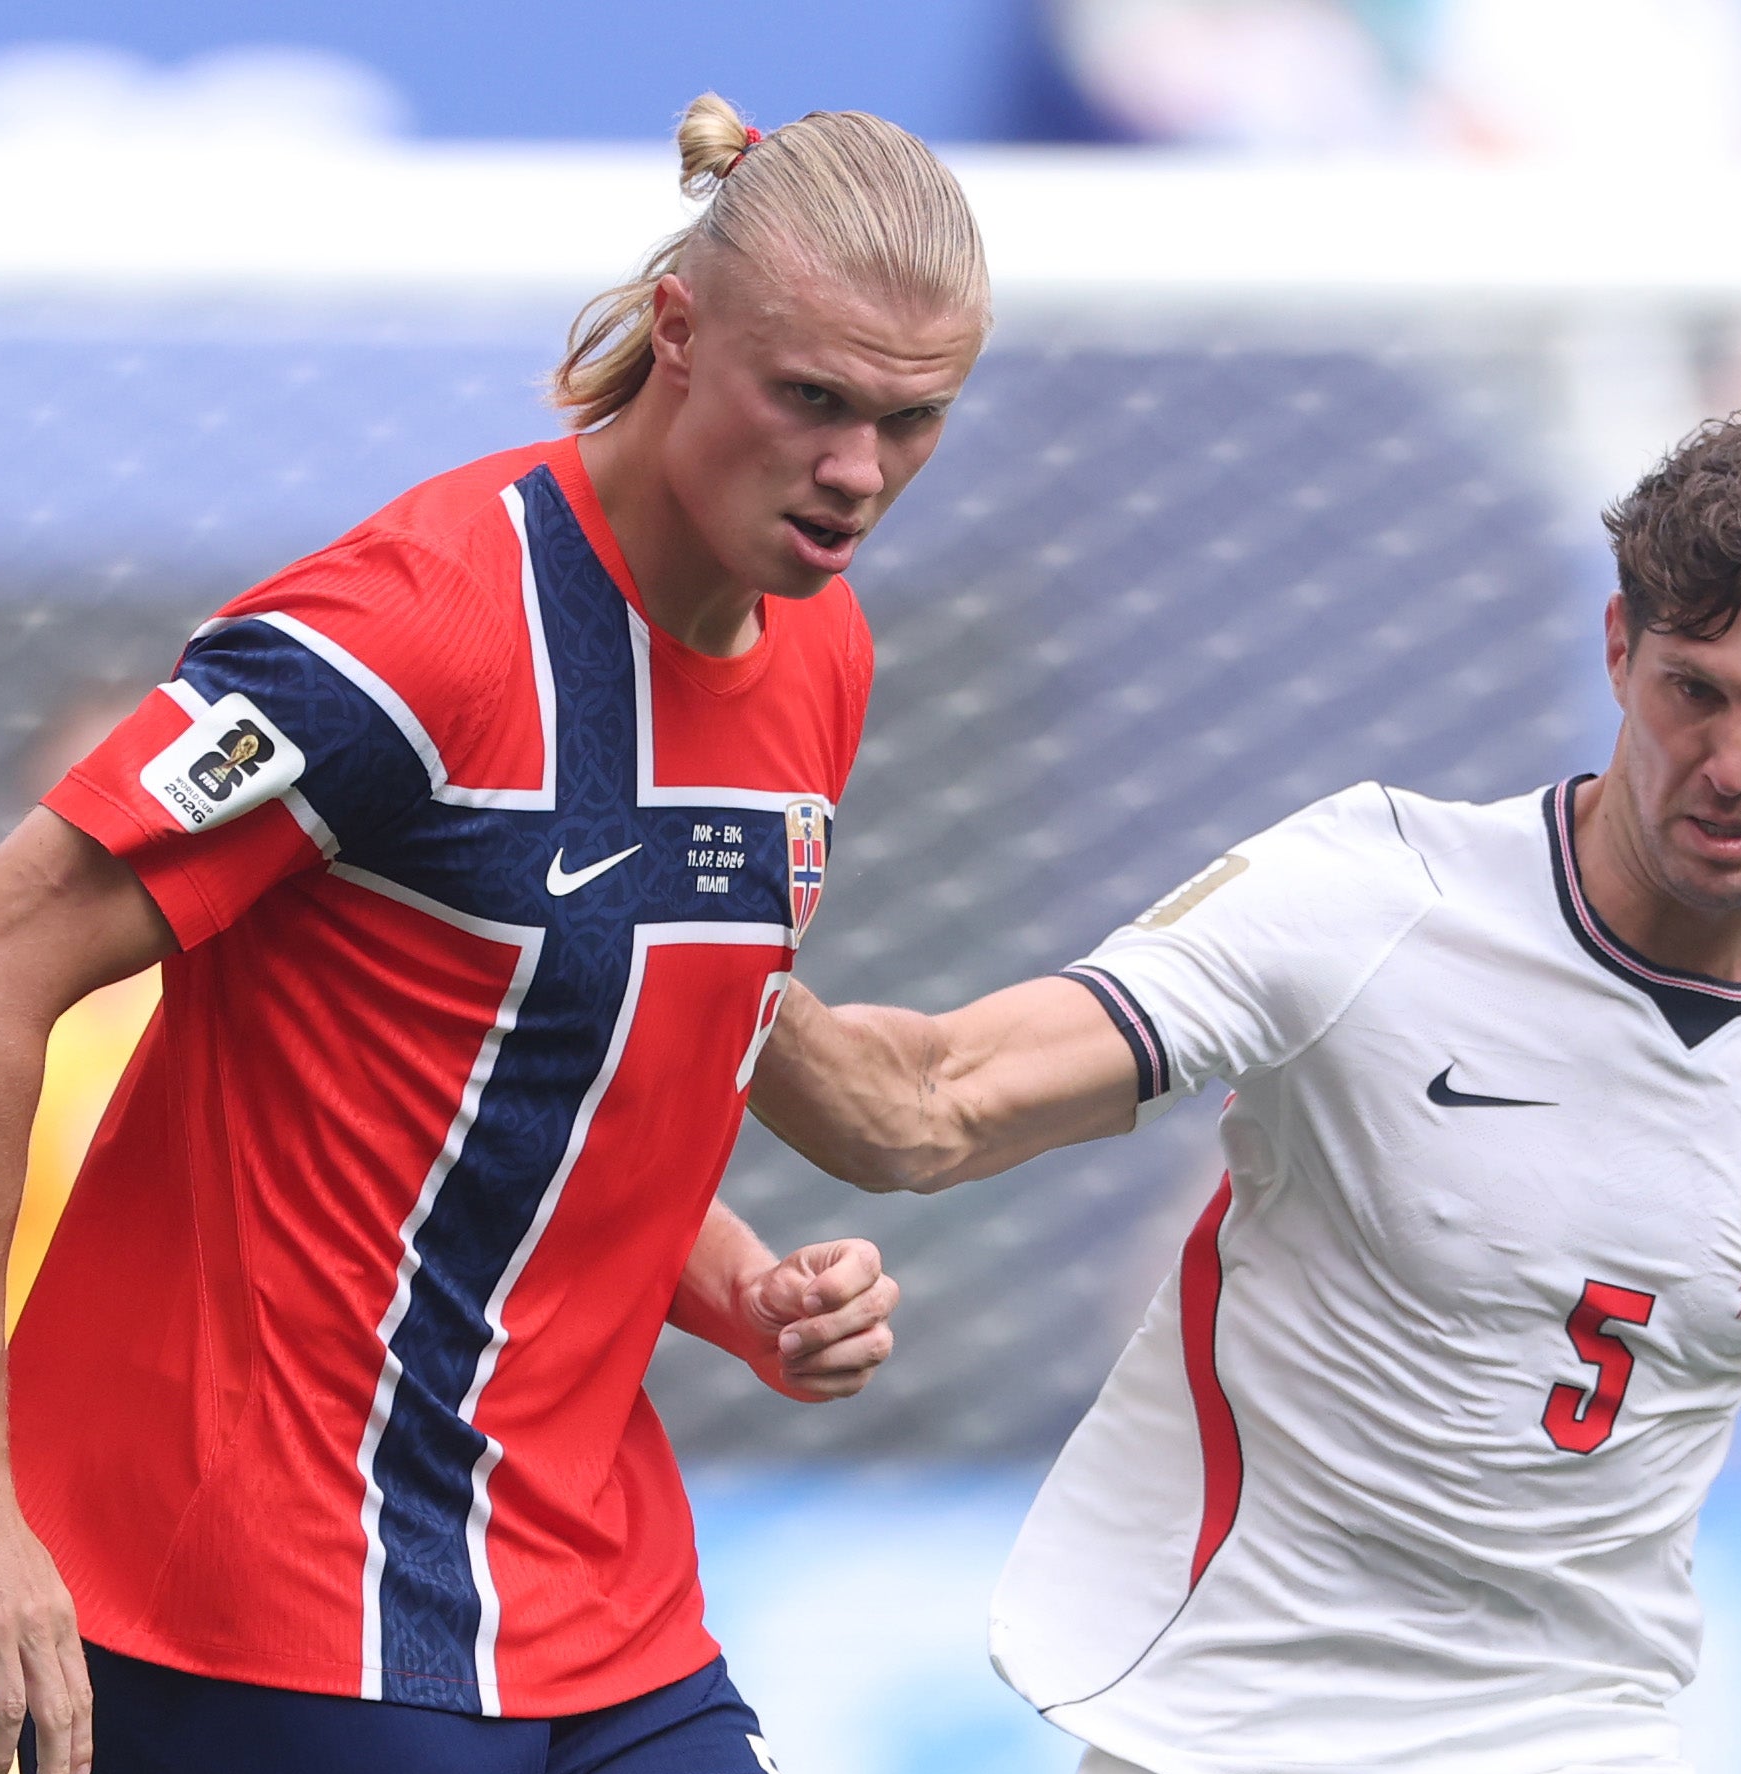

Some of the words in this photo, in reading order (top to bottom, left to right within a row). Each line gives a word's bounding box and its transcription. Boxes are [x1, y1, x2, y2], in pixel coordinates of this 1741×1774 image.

[174, 775, 200, 801] WORLD
[196, 798, 215, 815] CUP
[197, 771, 221, 794] FIFA
[163, 782, 207, 825] 2026
[692, 824, 713, 842] NOR
[723, 825, 743, 844] ENG
[696, 875, 729, 894] MIAMI
[1541, 1278, 1656, 1455] 5
